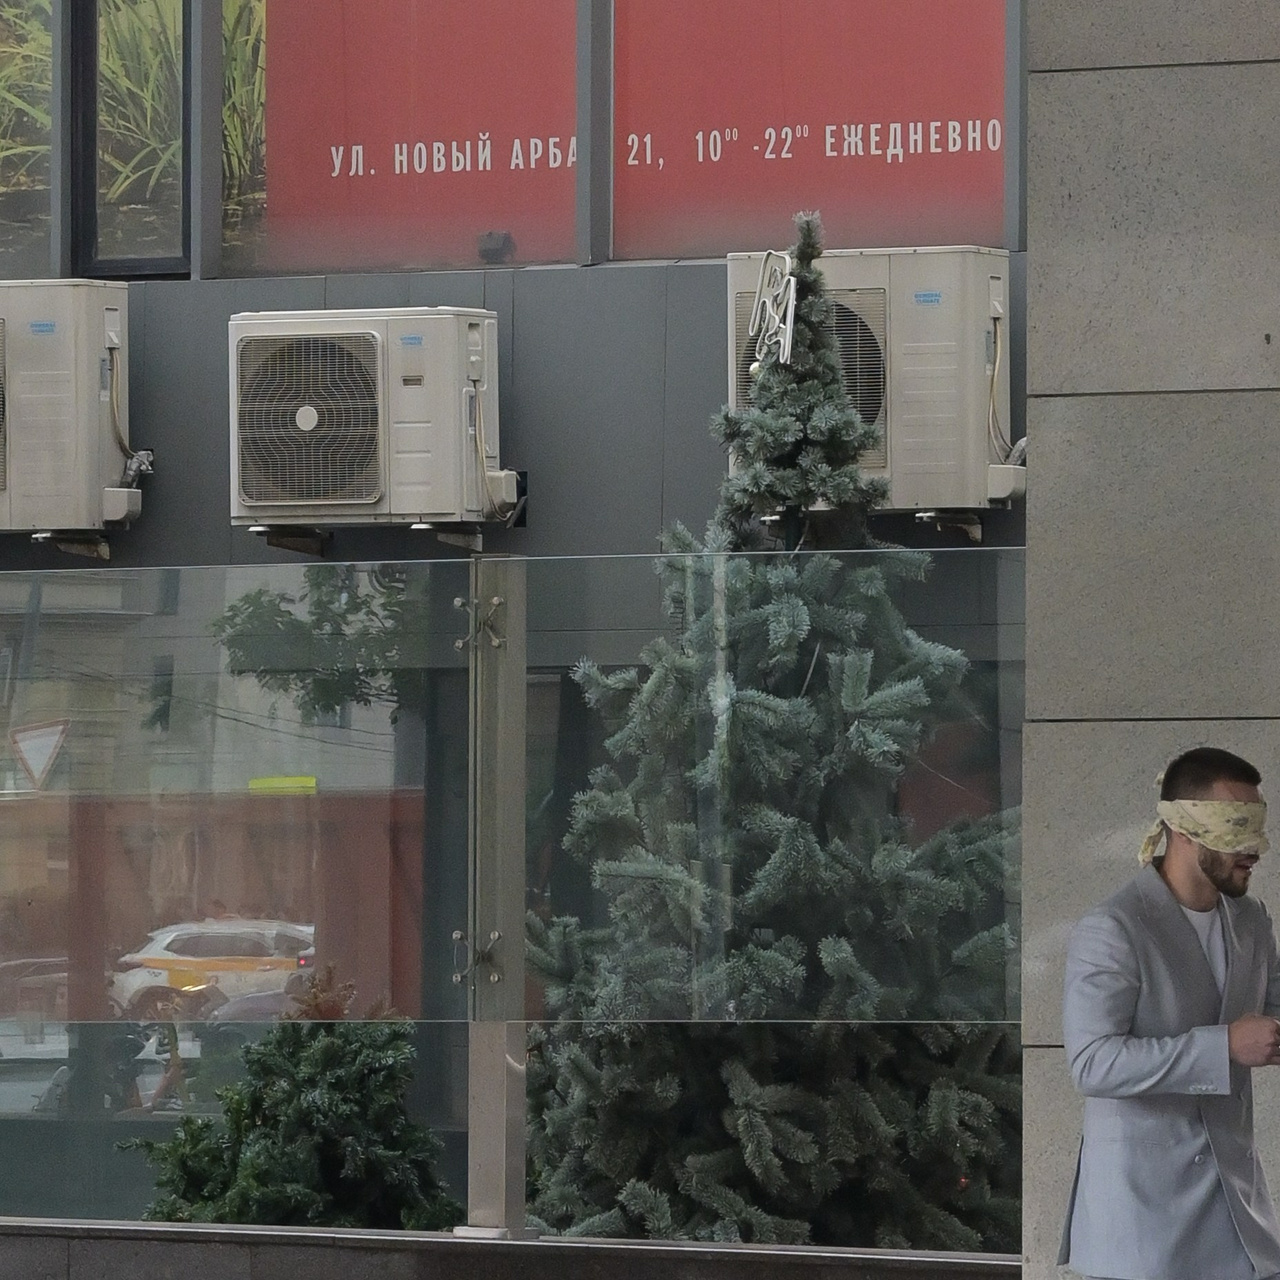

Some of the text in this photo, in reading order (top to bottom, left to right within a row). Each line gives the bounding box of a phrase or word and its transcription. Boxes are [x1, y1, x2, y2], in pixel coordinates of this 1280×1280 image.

[330, 145, 376, 178] УЛ.
[394, 131, 492, 175] НОВЫЙ
[509, 136, 577, 170] АРБА
[626, 133, 665, 170] 21,
[824, 118, 1002, 164] ЕЖЕДНЕВНО
